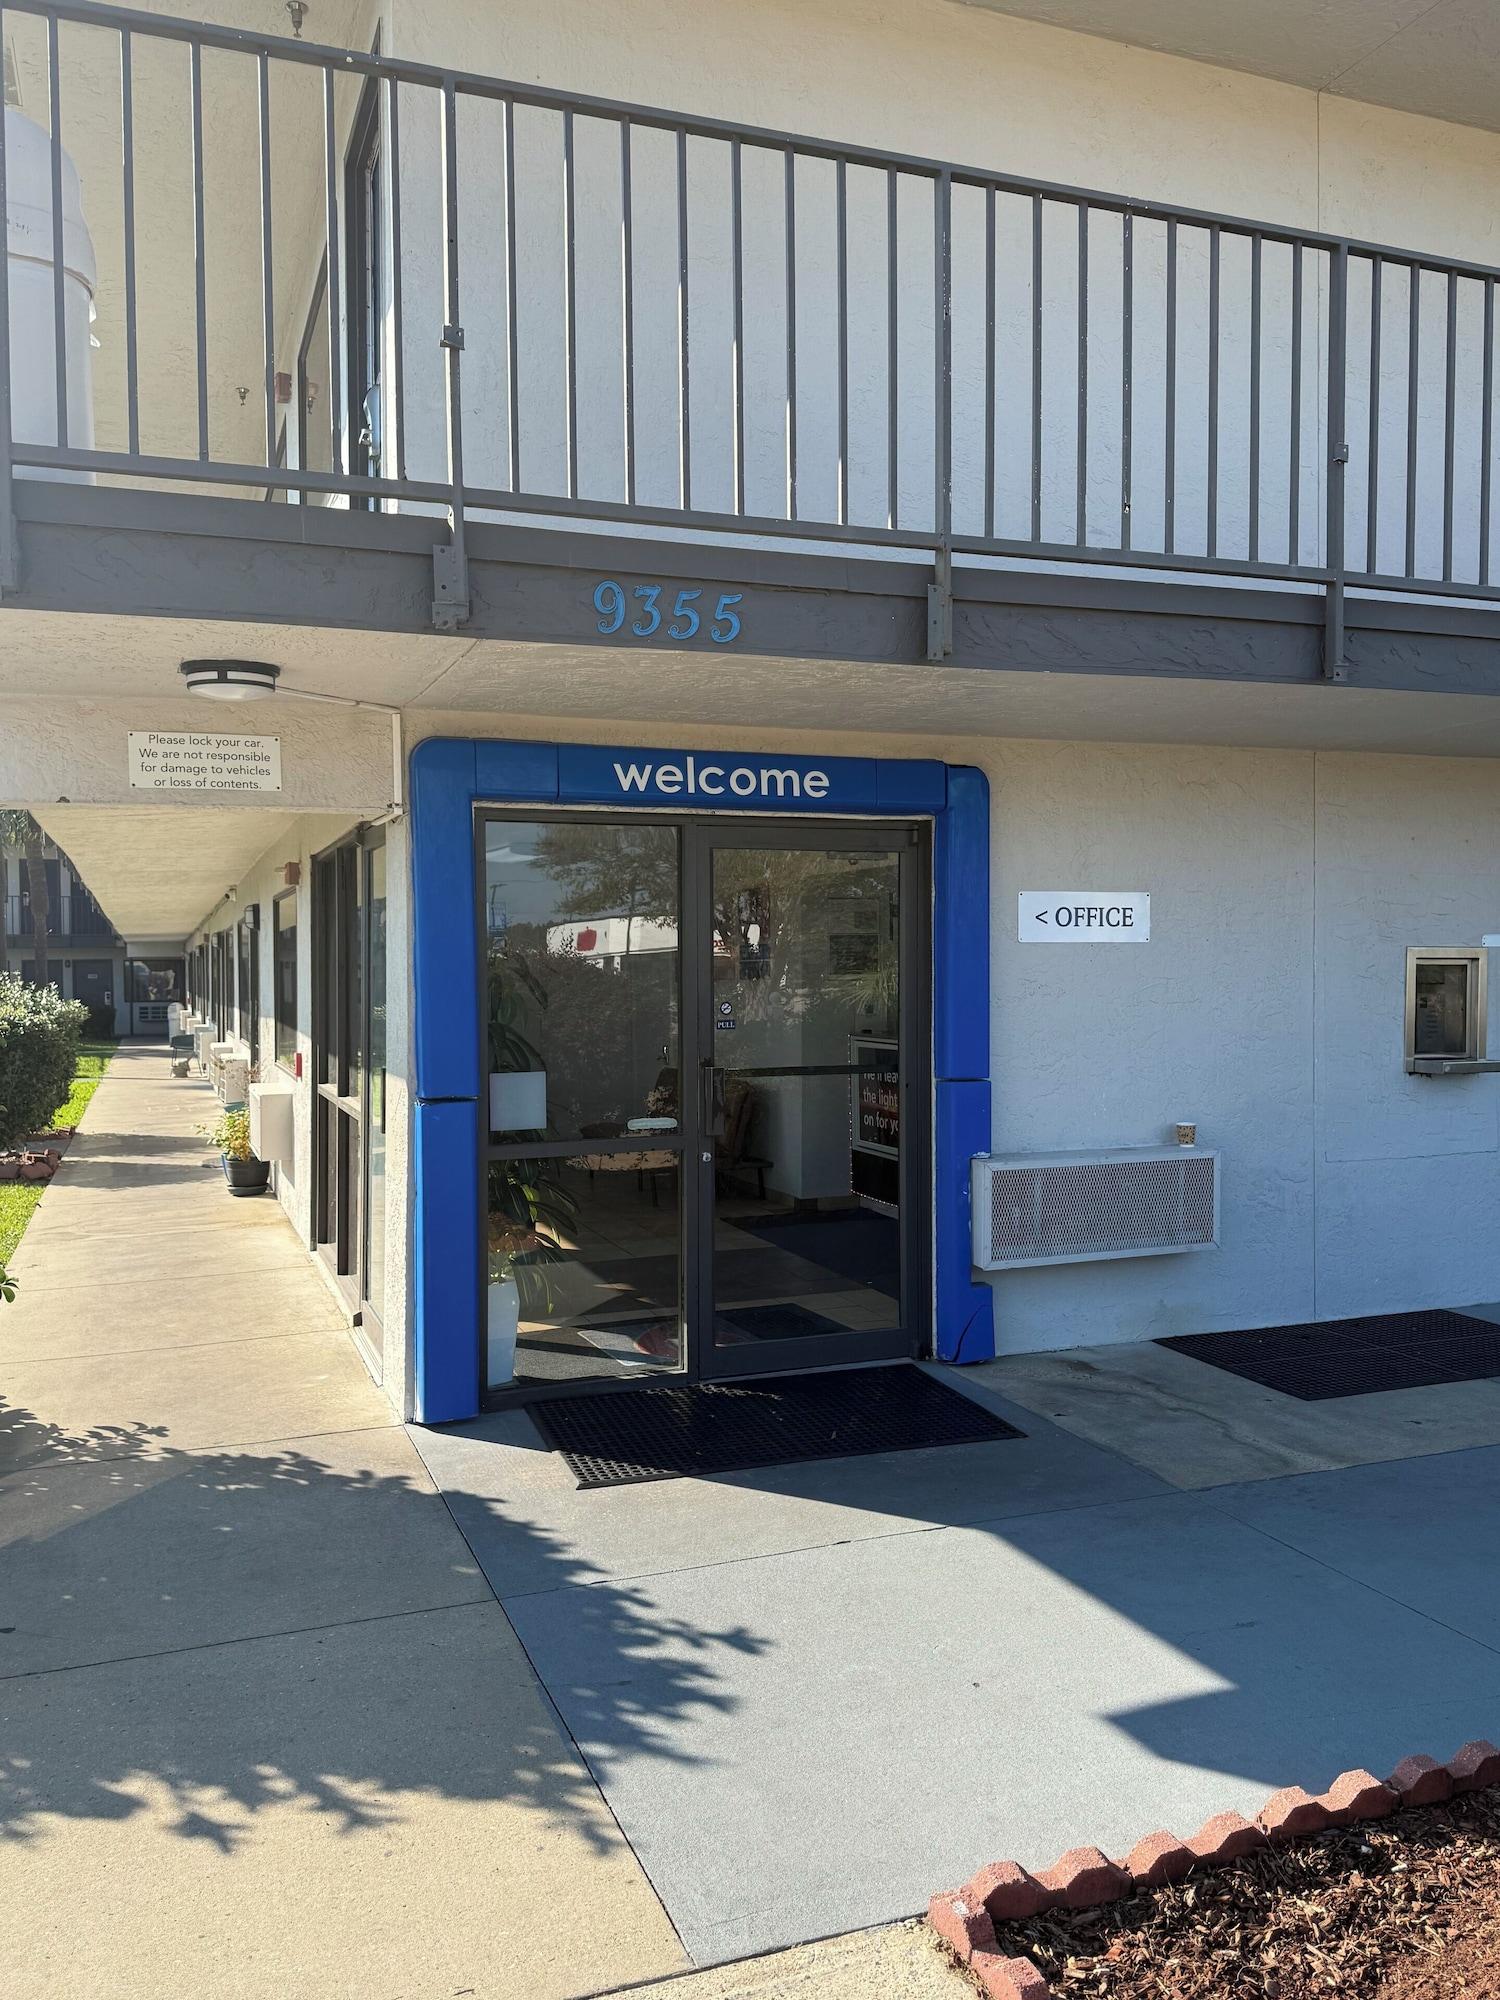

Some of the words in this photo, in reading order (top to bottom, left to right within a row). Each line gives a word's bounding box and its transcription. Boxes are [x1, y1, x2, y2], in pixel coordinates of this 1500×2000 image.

[593, 579, 744, 643] 9355
[148, 734, 186, 745] Please
[189, 735, 213, 746] lock
[215, 739, 241, 749] your
[244, 740, 264, 748] car.
[138, 748, 158, 758] We
[162, 751, 180, 759] are
[183, 751, 203, 759] not
[206, 752, 271, 763] responsible
[141, 762, 157, 772] for
[160, 763, 208, 776] damage
[211, 766, 223, 774] to
[226, 765, 271, 776] vehicles
[613, 756, 830, 798] welcome
[154, 779, 166, 787] or
[170, 777, 192, 787] loss
[195, 777, 207, 788] of
[210, 780, 262, 790] contents.
[1055, 906, 1134, 927] OFFICE
[863, 1087, 876, 1104] the
[878, 1088, 898, 1110] light
[863, 1113, 874, 1127] on
[876, 1111, 888, 1129] for
